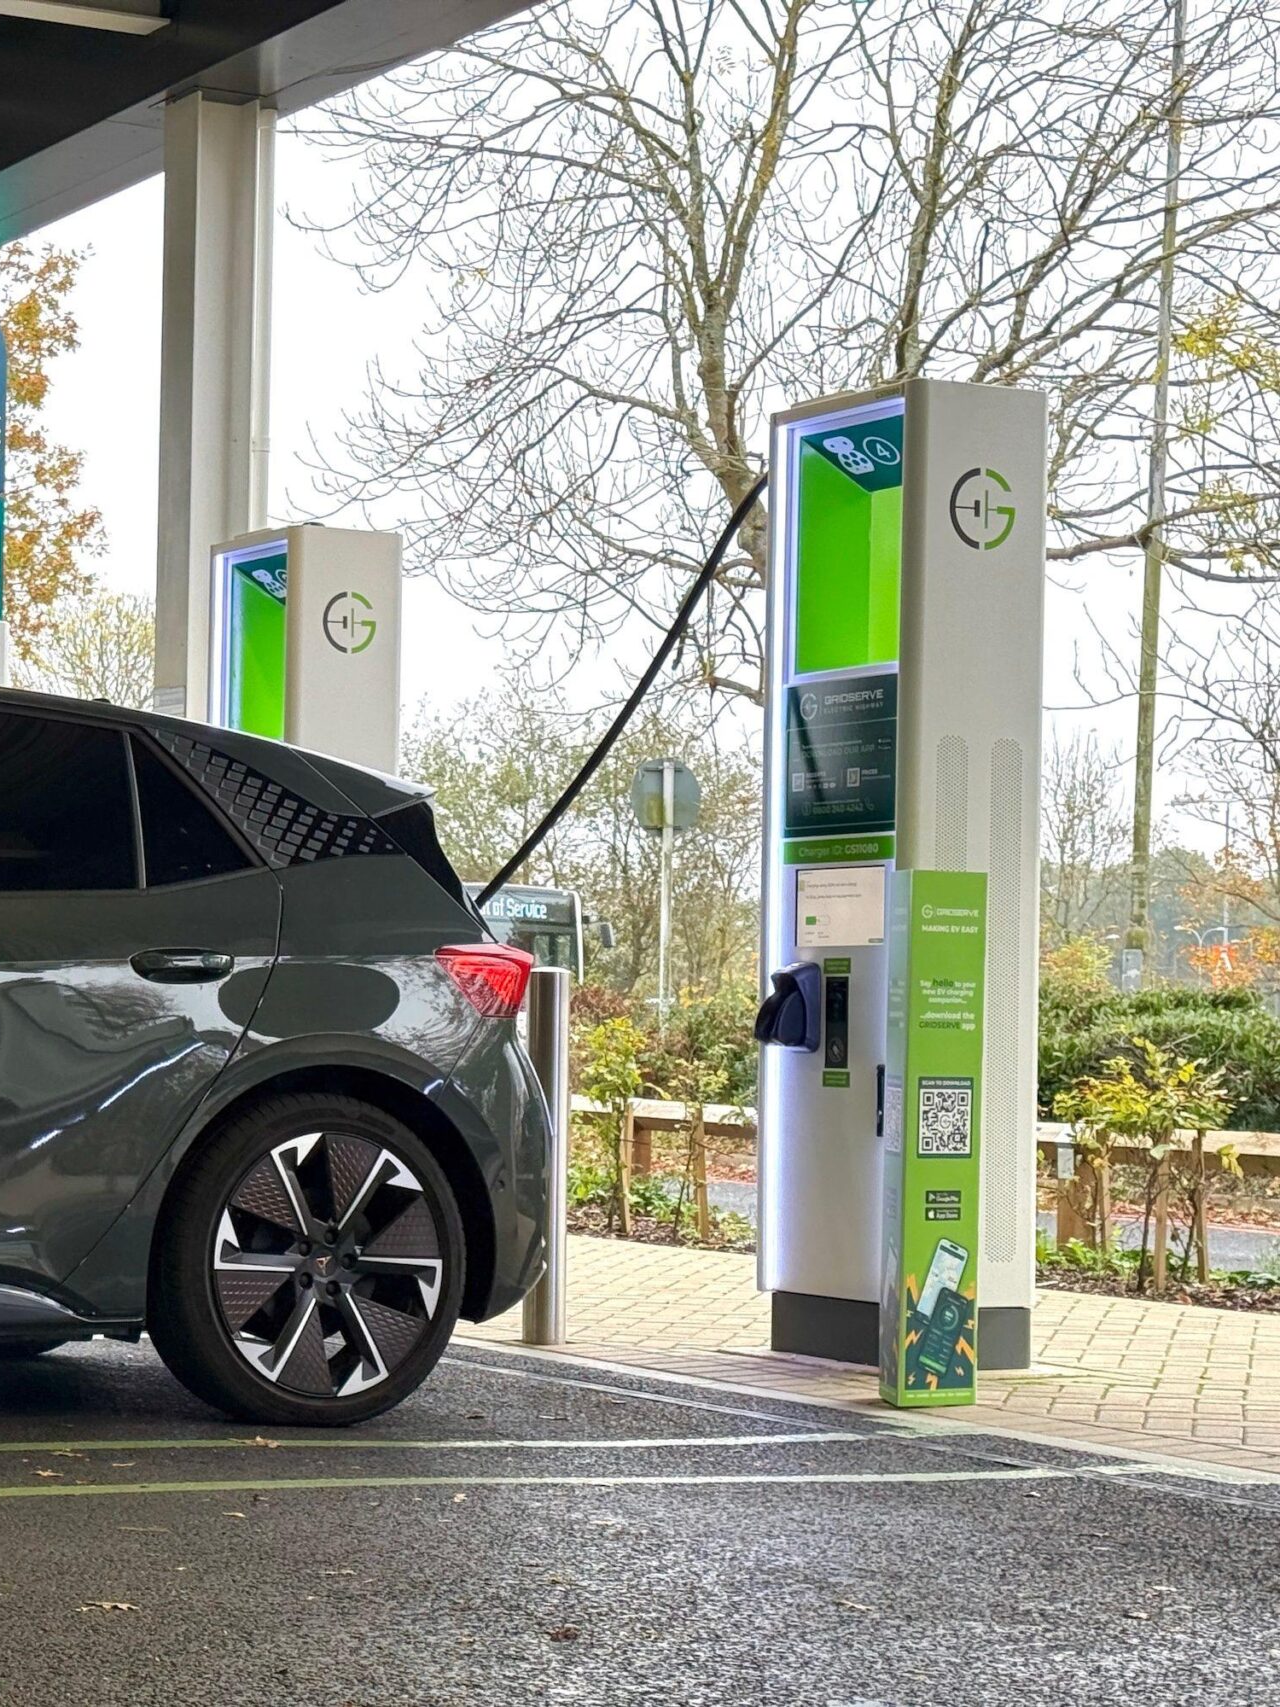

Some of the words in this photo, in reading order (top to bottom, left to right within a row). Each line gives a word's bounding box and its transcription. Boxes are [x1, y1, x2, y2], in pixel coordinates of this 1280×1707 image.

[876, 443, 892, 459] 4
[824, 689, 884, 705] GRIDSERVE
[799, 847, 830, 858] Charger
[492, 898, 504, 916] of
[506, 898, 547, 919] Service
[936, 908, 979, 917] GRIDSERVE
[921, 924, 949, 933] MAKING
[951, 925, 960, 933] EV
[932, 978, 955, 987] hello
[946, 989, 974, 997] charging
[962, 1012, 975, 1020] the
[919, 1021, 961, 1029] GRIDSERVE
[961, 1023, 976, 1031] app
